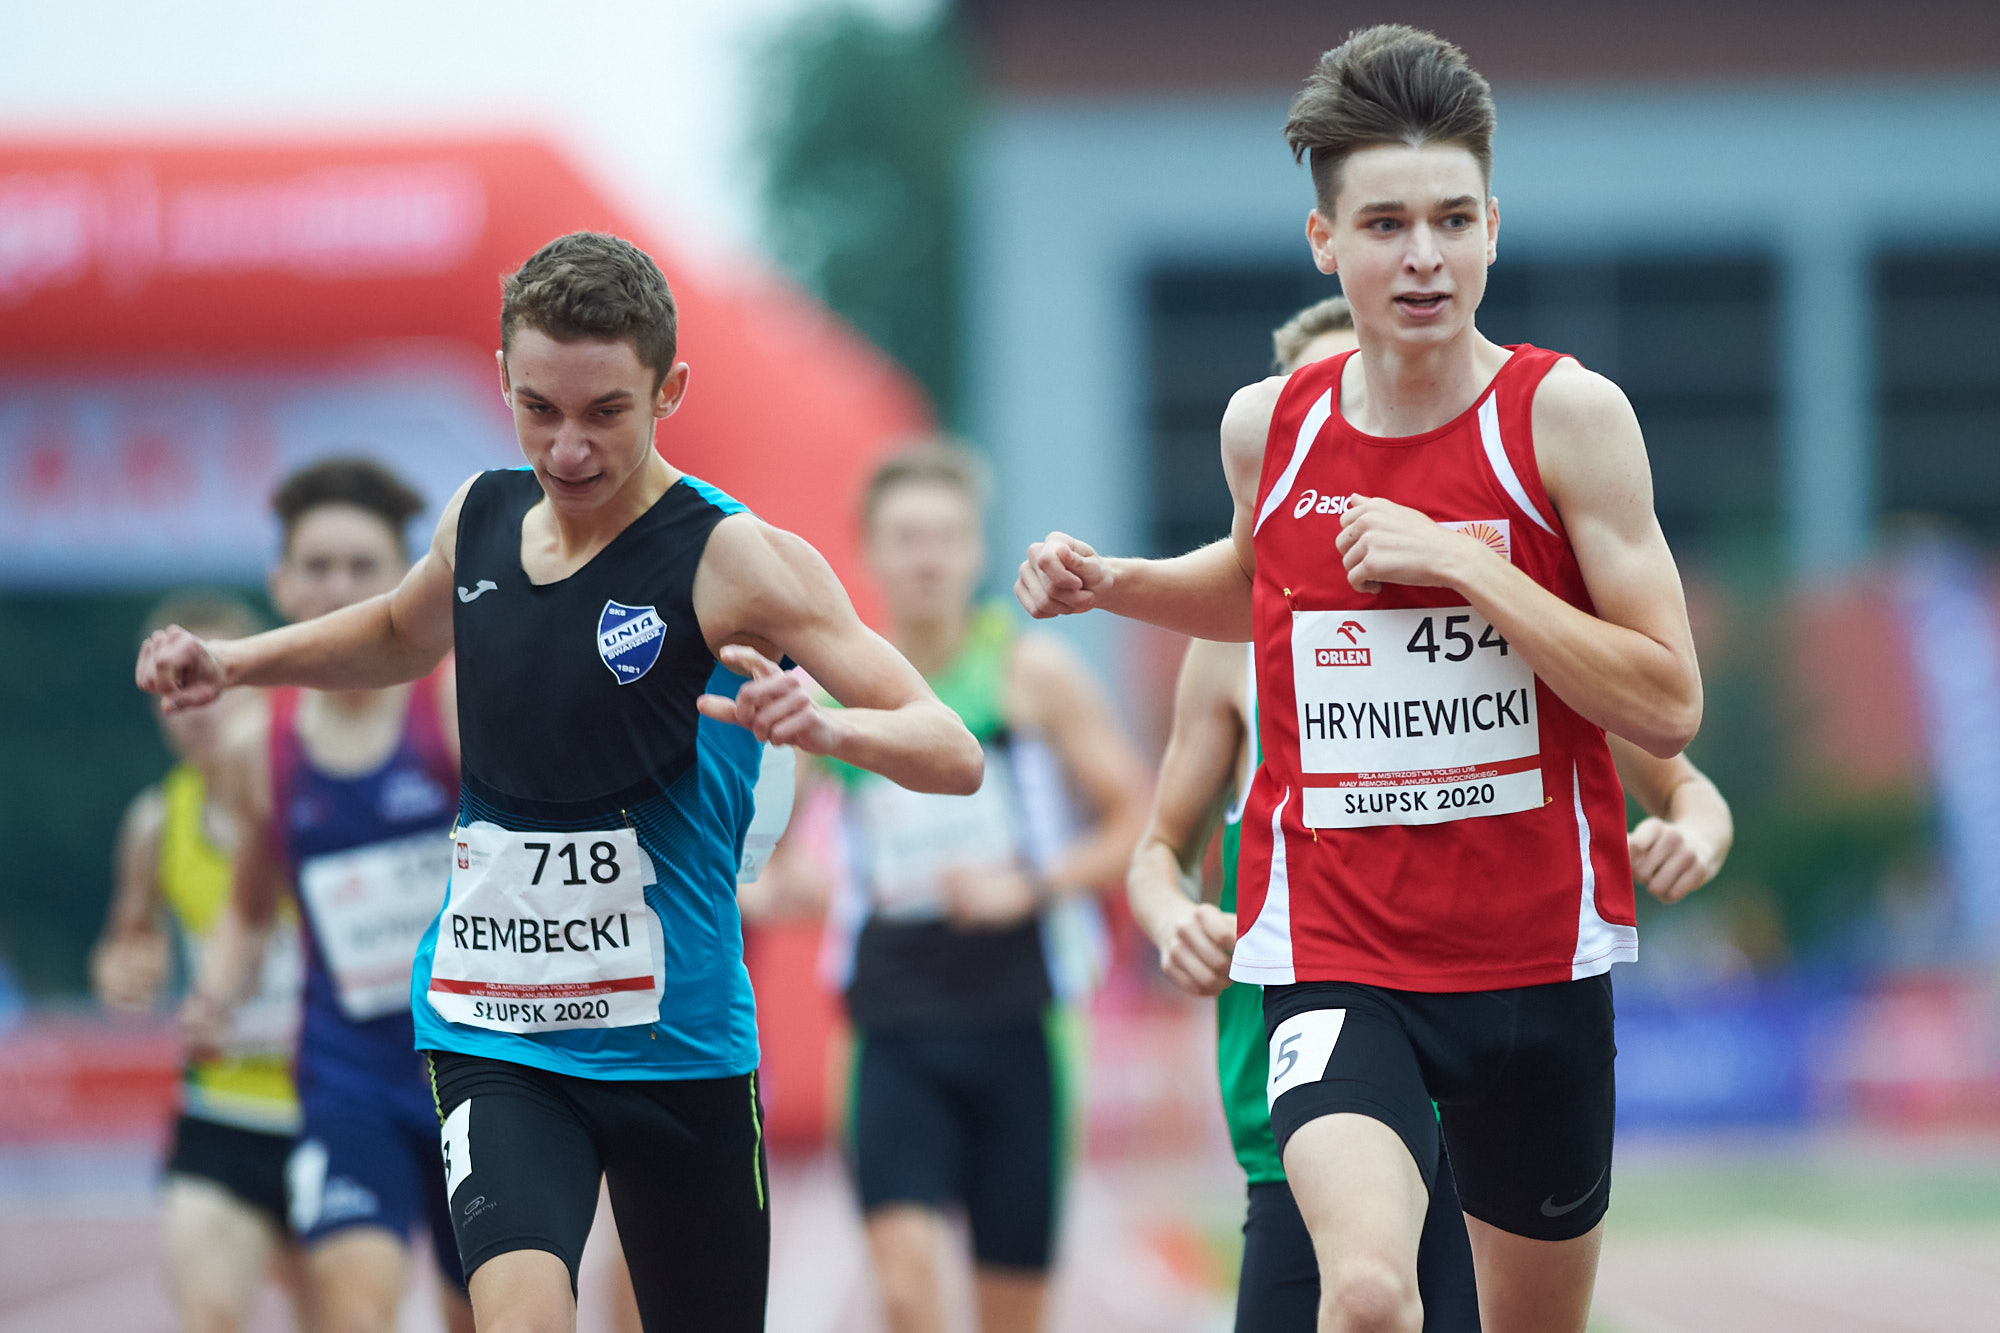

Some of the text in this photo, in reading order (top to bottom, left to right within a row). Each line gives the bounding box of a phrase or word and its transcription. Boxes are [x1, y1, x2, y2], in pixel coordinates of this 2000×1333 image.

[1315, 495, 1353, 515] asic
[604, 616, 654, 647] UNIA
[1406, 614, 1510, 663] 454
[616, 664, 640, 674] 1921
[1317, 650, 1368, 664] ORLEN
[1305, 688, 1529, 740] HRYNIEWICKI
[1377, 769, 1432, 779] MISTRZOSTWA
[1433, 767, 1460, 776] POLSKI
[1399, 777, 1436, 786] JANUSZA
[1344, 783, 1495, 814] SŁUPSK 2020
[524, 841, 621, 886] 718
[452, 913, 631, 954] REMBECKI
[473, 999, 610, 1023] SŁUPSK 2020
[1273, 1032, 1303, 1084] 5
